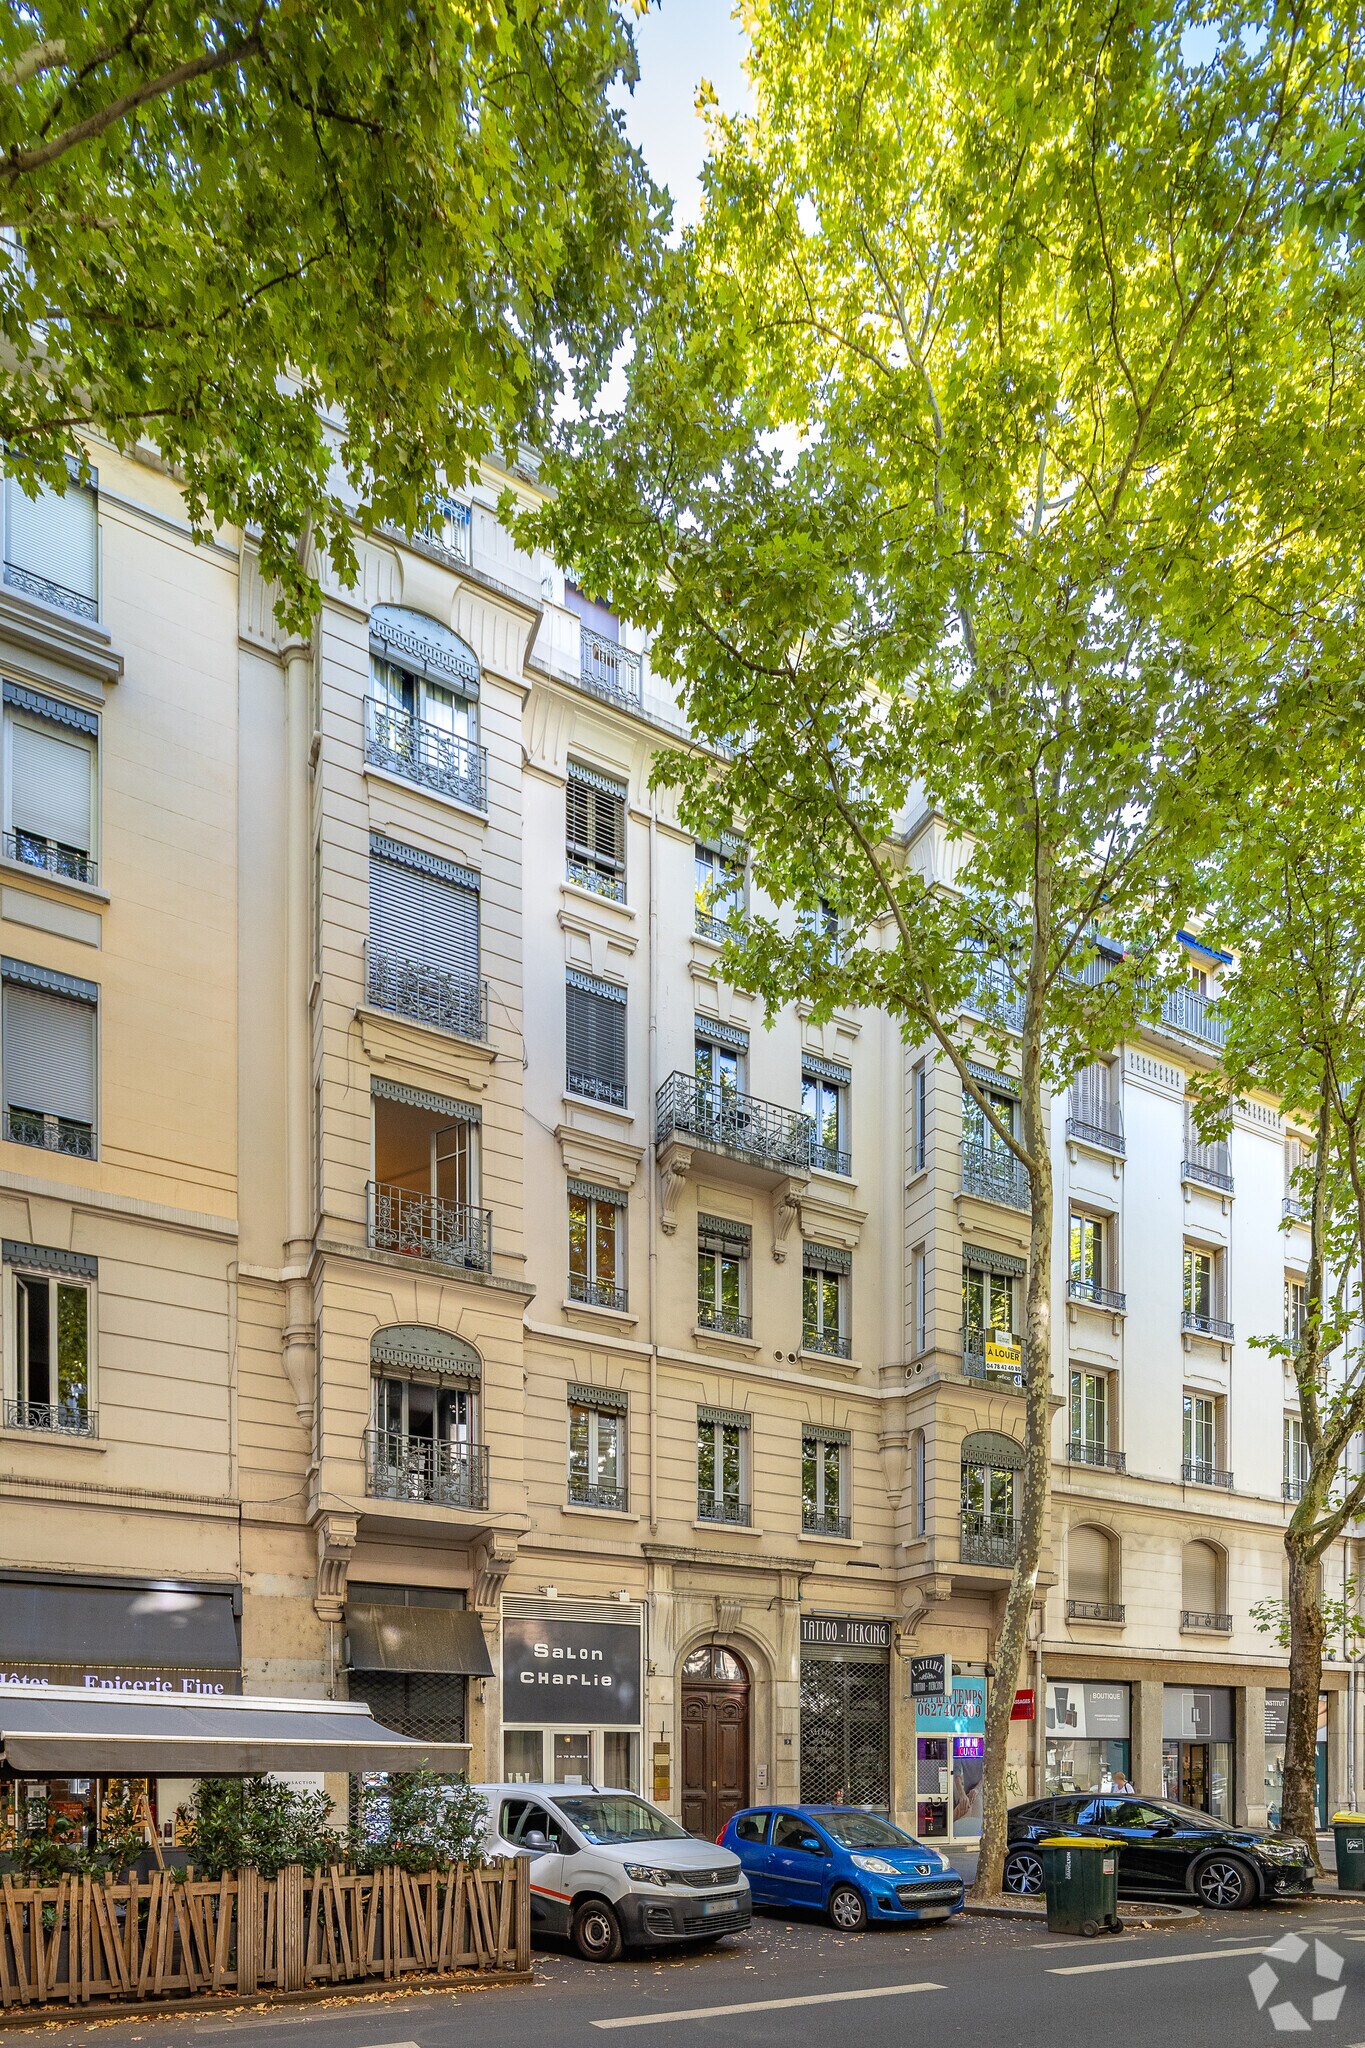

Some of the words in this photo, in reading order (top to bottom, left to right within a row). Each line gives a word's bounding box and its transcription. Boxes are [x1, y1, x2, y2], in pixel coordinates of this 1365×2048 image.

[987, 1346, 993, 1355] À
[995, 1349, 1020, 1361] LOUER
[802, 1620, 838, 1641] TATTOO
[846, 1623, 886, 1644] PIERCING
[911, 1659, 944, 1677] L'ATELIER
[181, 1678, 224, 1695] Fine
[1092, 1692, 1121, 1700] BOUTIQUE
[917, 1703, 981, 1718] 0627407809
